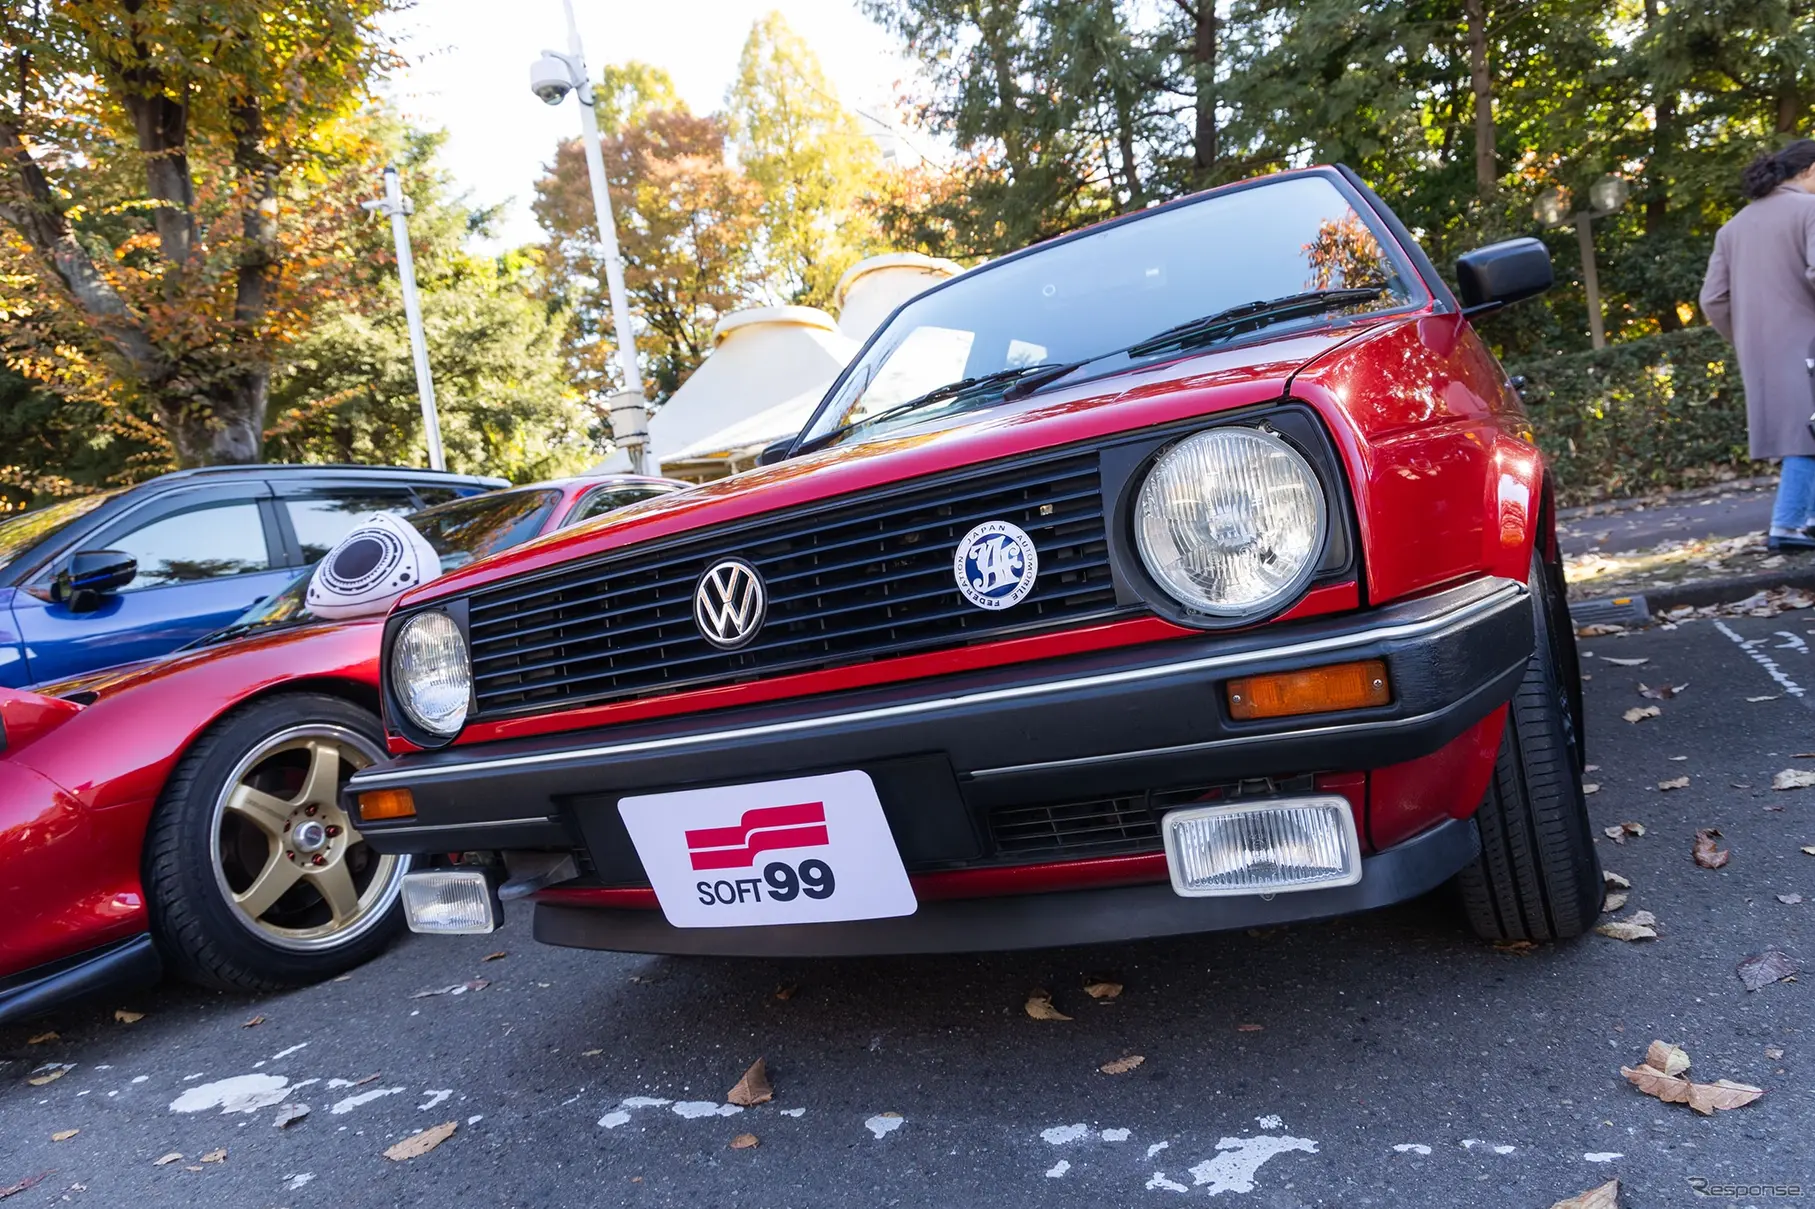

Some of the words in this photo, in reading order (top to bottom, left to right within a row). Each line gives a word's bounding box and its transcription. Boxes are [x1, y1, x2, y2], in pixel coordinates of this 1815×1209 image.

[967, 524, 1006, 544] JAPAN
[957, 555, 1000, 607] FEDERATION
[1011, 534, 1033, 601] AUTOMOBILE
[697, 561, 763, 643] VW
